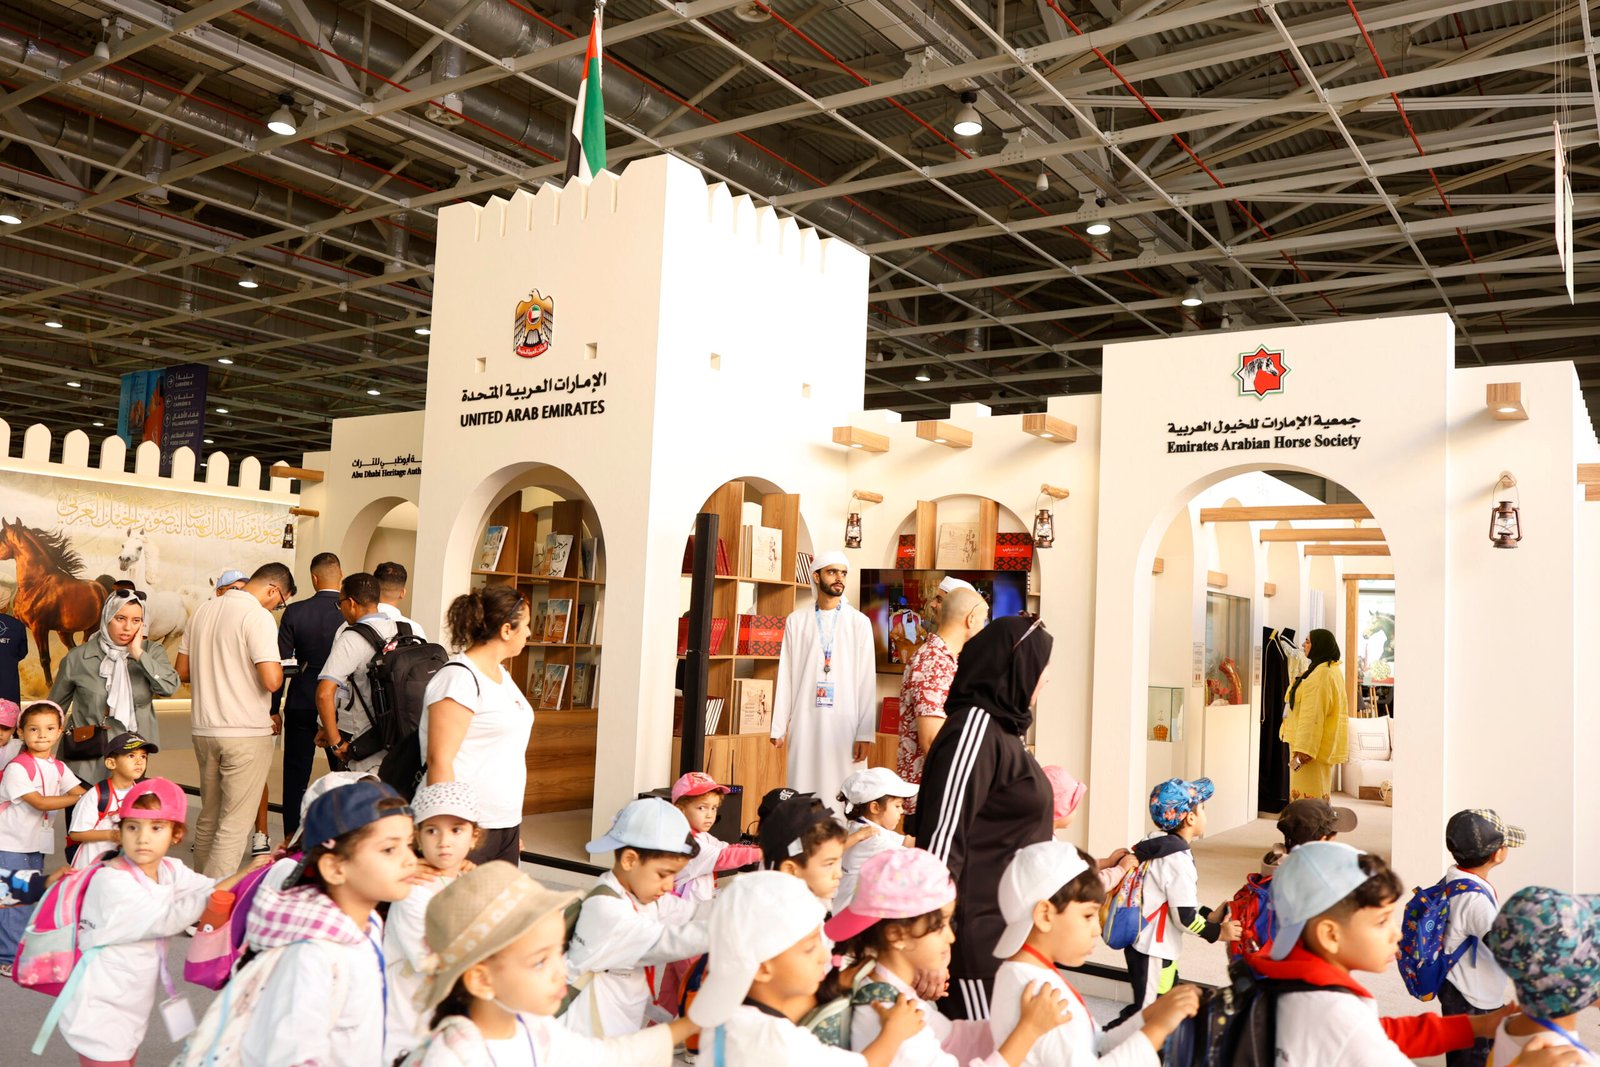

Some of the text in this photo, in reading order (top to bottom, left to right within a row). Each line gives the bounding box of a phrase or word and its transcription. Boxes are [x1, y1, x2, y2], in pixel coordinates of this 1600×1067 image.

[461, 371, 607, 402] الإمارات العربية المتحدة
[460, 399, 605, 427] UNITED ARAB EMIRATES
[1167, 414, 1361, 436] جمعية الإمارات للخيول العربية
[1167, 434, 1361, 453] Emirates Arabian Horse Society
[351, 457, 380, 468] للتراث
[380, 453, 411, 469] أبوظبي
[351, 470, 363, 479] Abu
[364, 469, 381, 478] Dhabi
[382, 468, 406, 478] Heritage
